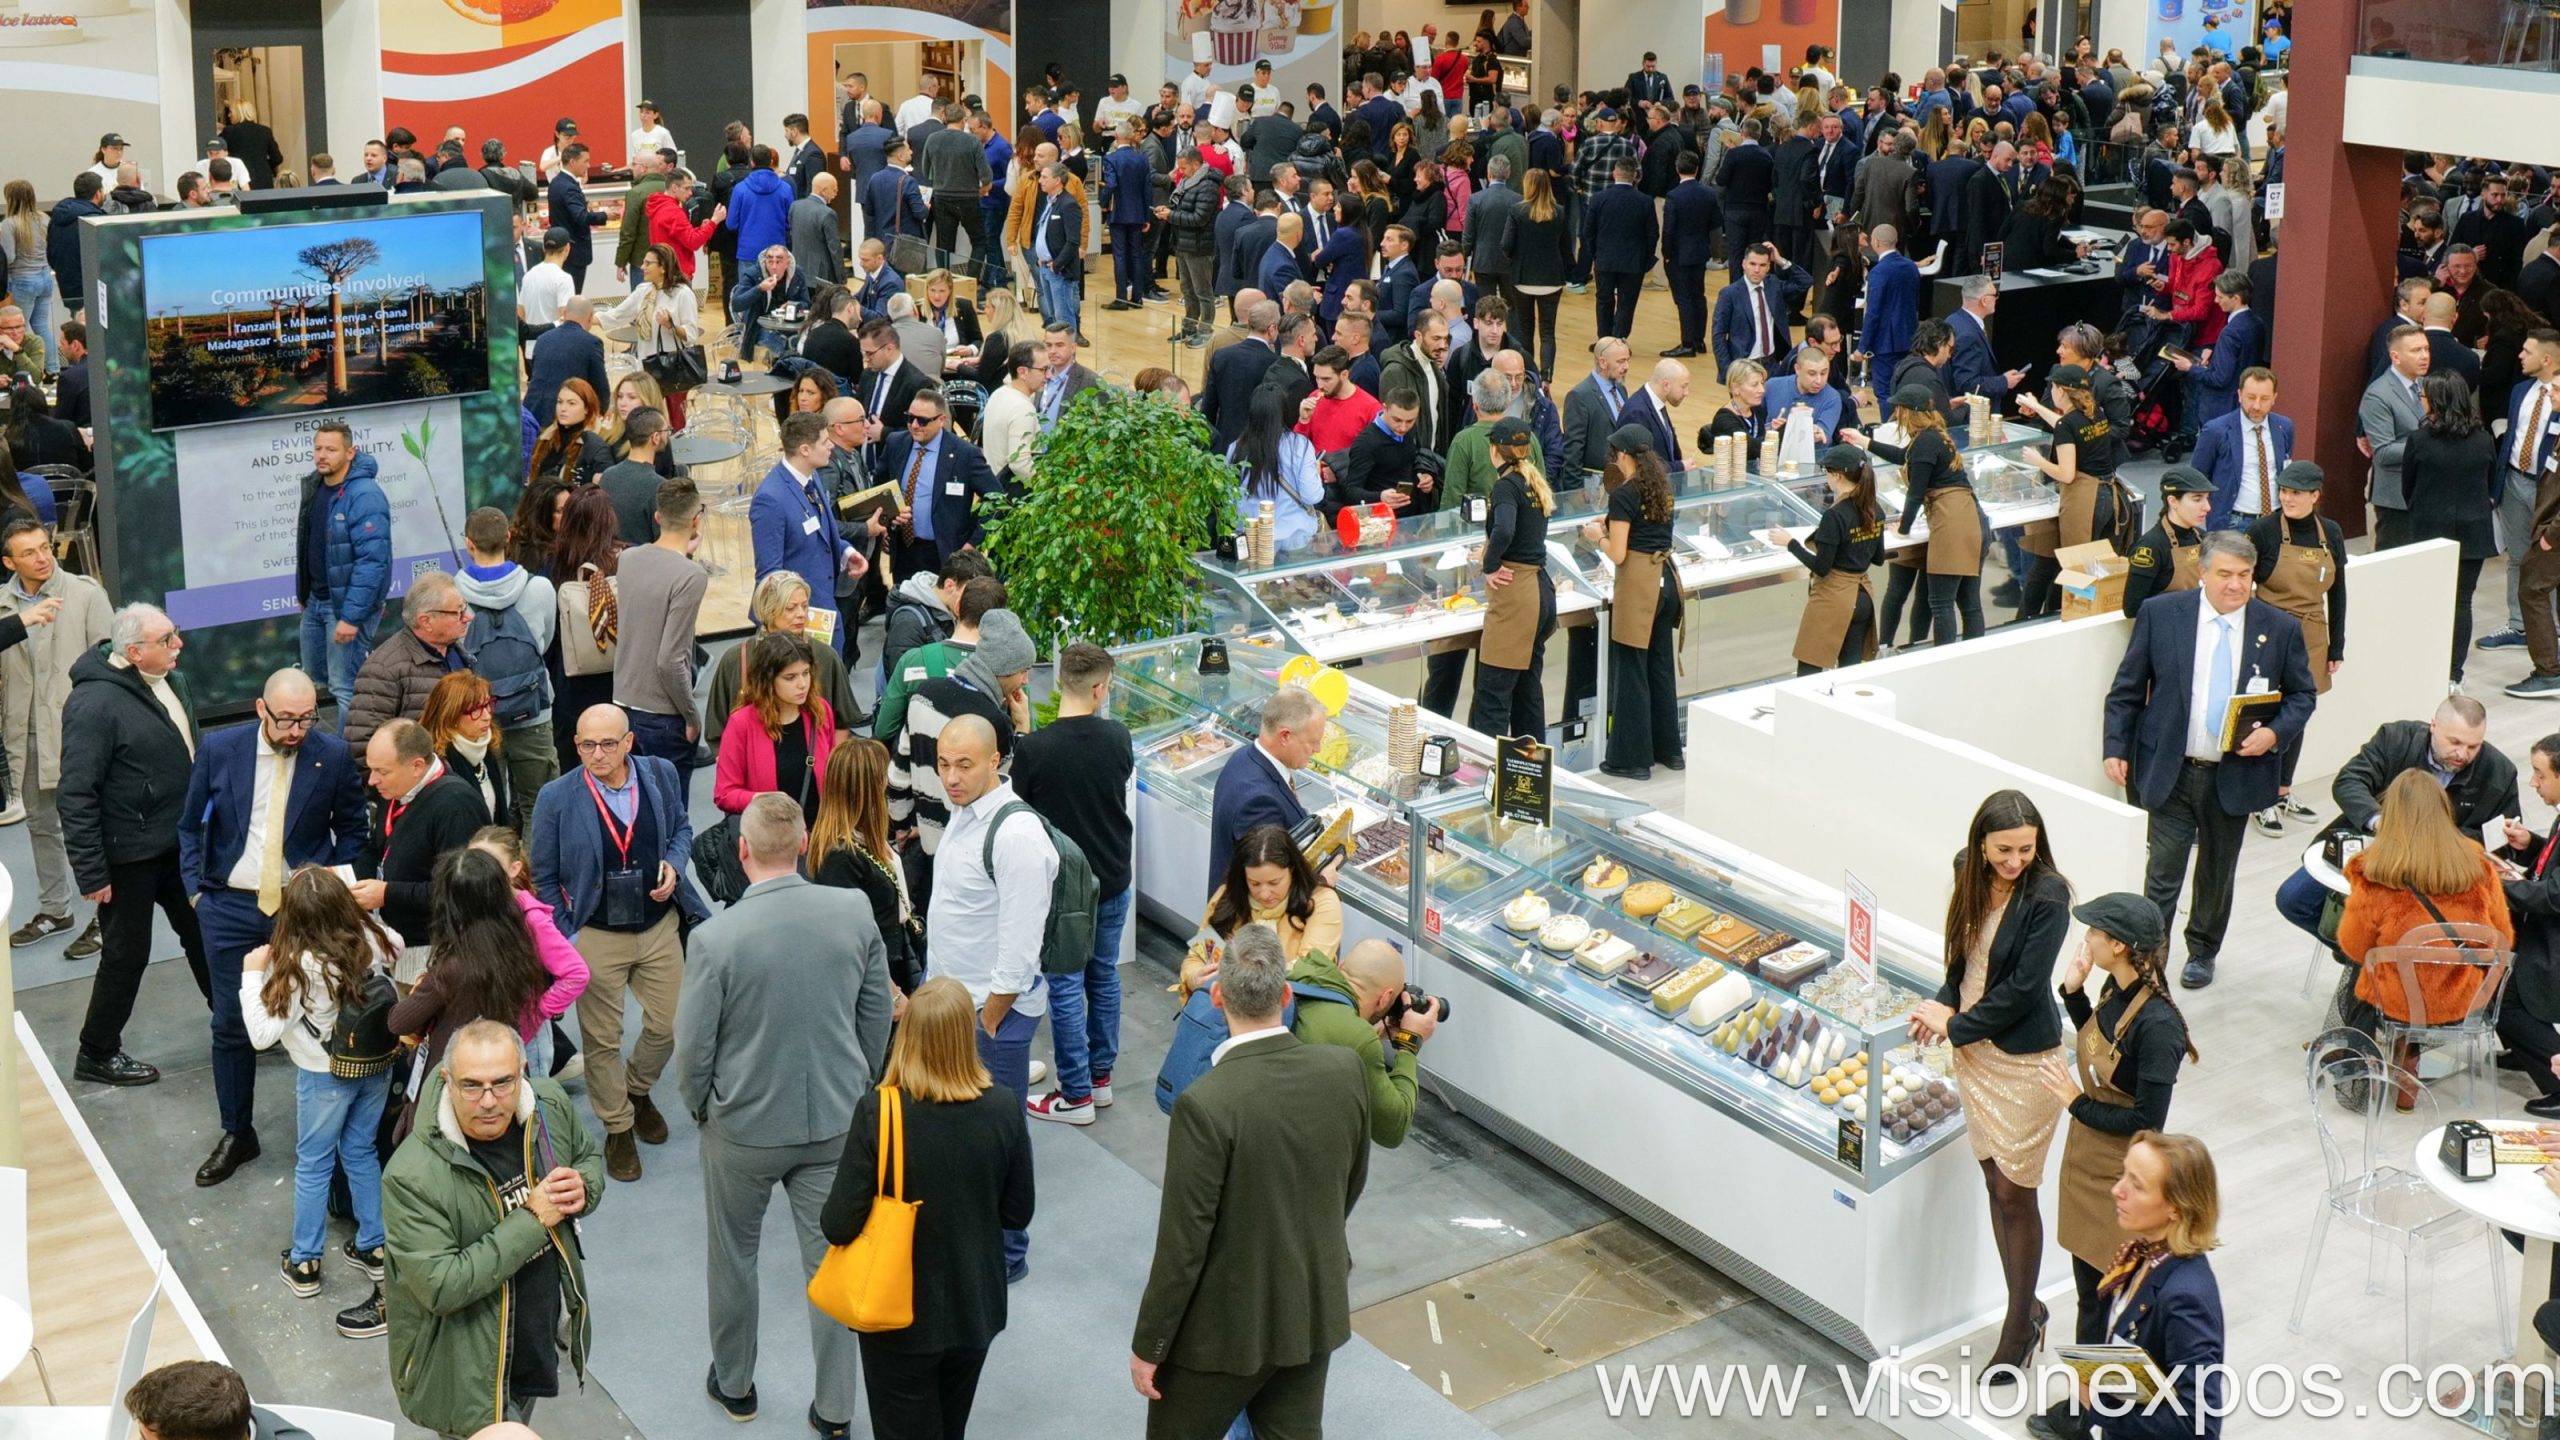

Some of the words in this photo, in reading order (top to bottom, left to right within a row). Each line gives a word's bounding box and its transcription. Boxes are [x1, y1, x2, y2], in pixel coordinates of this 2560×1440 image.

[2269, 191, 2281, 201] C7
[211, 280, 341, 306] Communities
[347, 271, 426, 293] involved
[234, 321, 282, 334] Tanzania
[290, 315, 327, 328] Malawi
[335, 313, 367, 326] Kenya
[374, 309, 408, 320] Ghana
[207, 337, 271, 352] Madagascar
[280, 330, 336, 344] Guatemala
[344, 325, 374, 339] Nepal
[382, 320, 434, 333] Cameroon
[272, 428, 371, 451] ENVIRNT
[252, 455, 280, 469] AND
[273, 473, 293, 484] We
[242, 491, 254, 502] to
[257, 488, 276, 500] the
[275, 499, 297, 511] and
[234, 519, 257, 531] This
[259, 517, 269, 528] is
[271, 514, 295, 526] how
[254, 531, 266, 543] of
[269, 528, 288, 541] the
